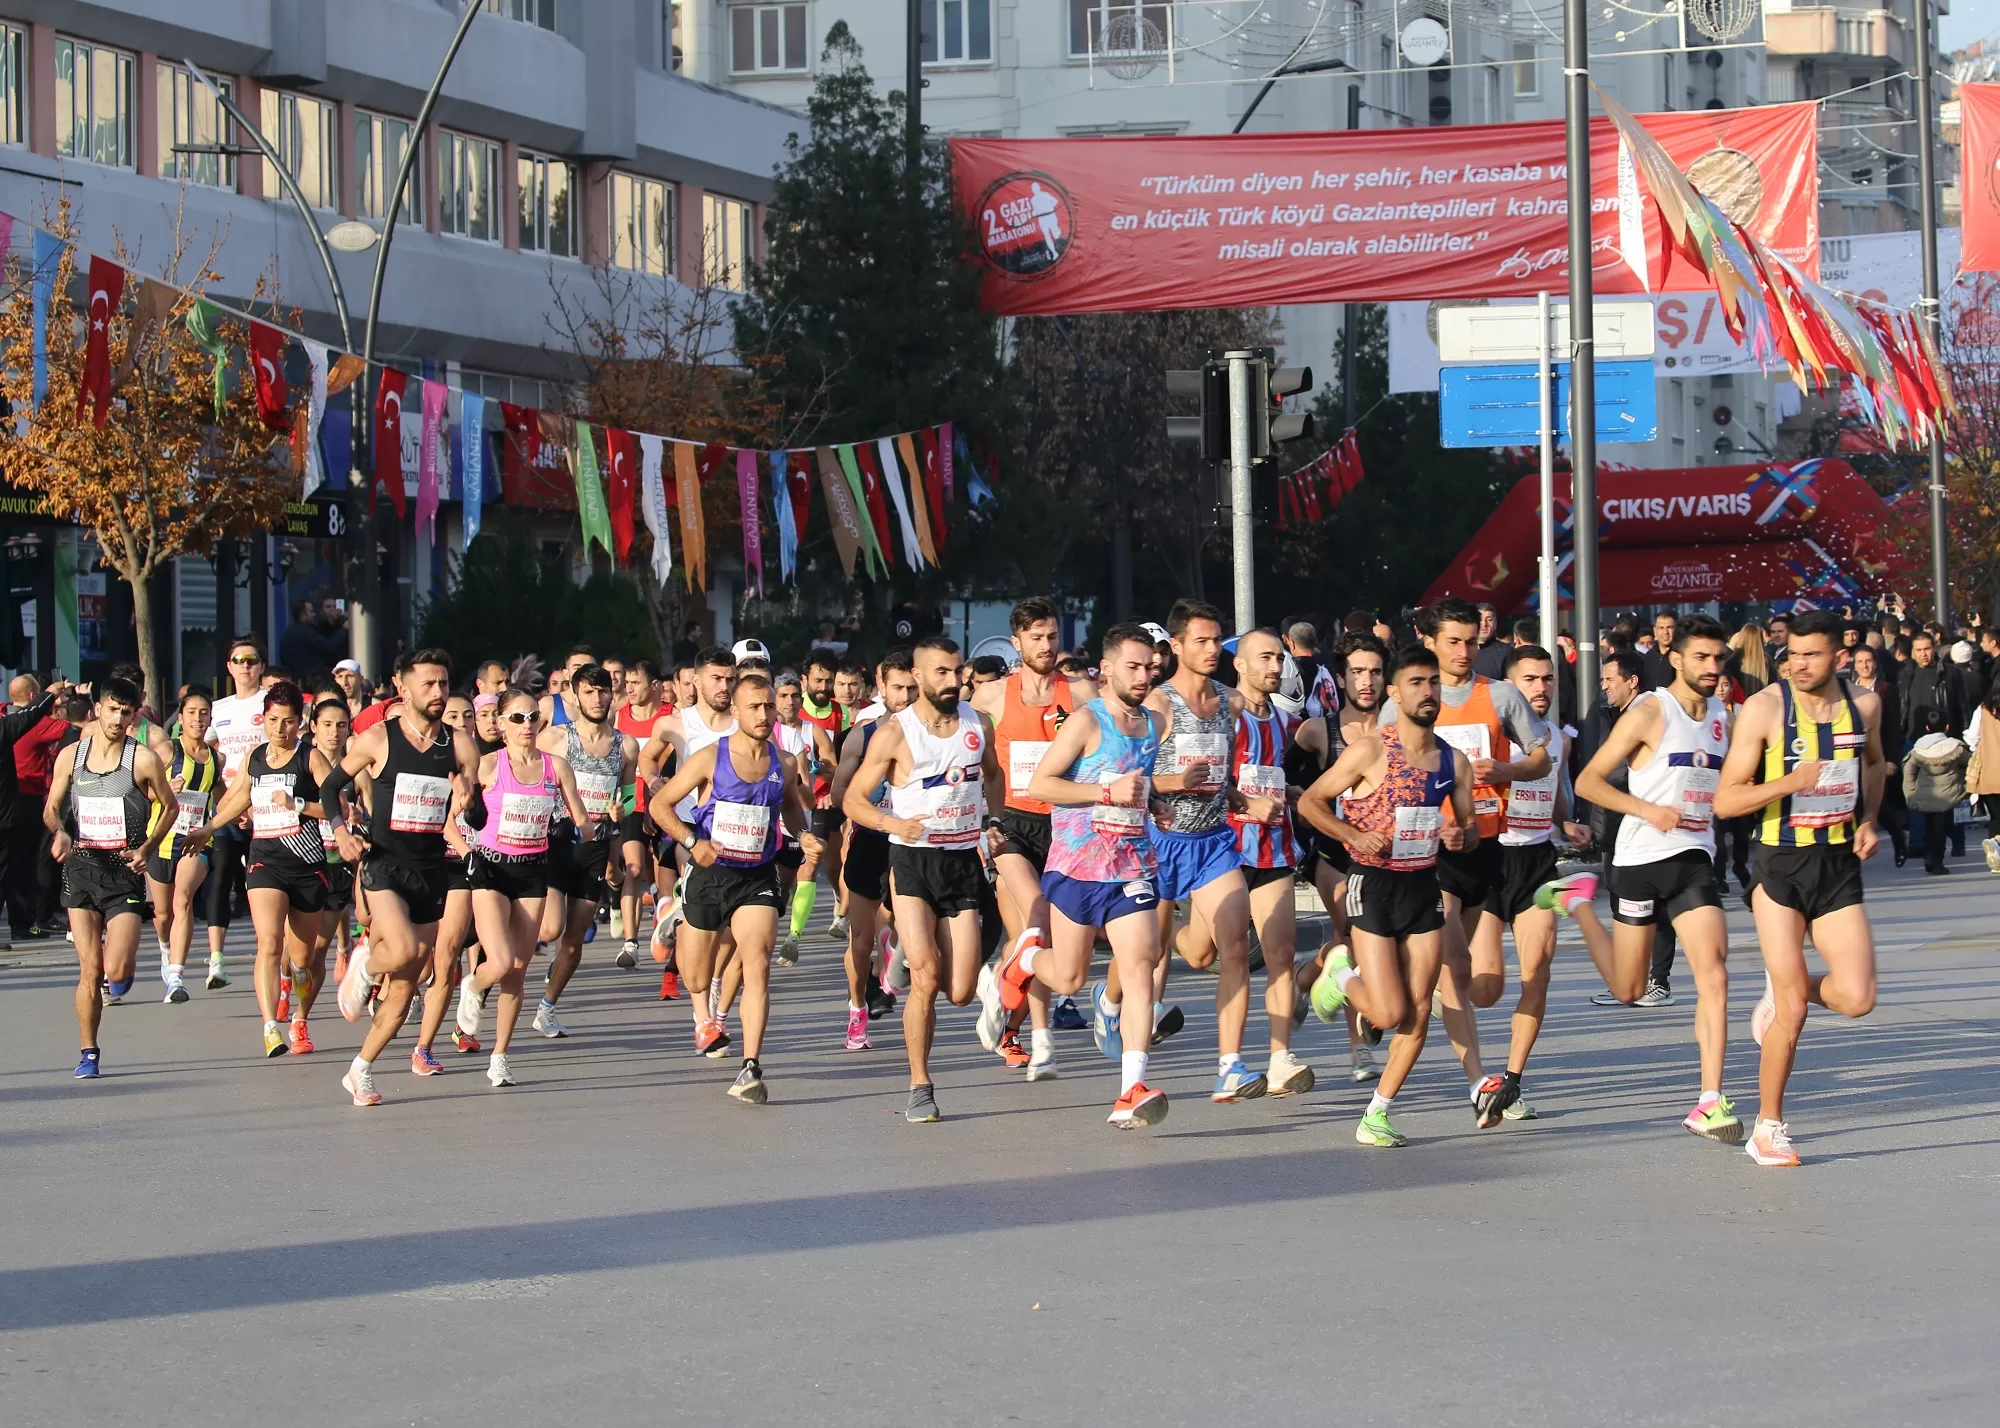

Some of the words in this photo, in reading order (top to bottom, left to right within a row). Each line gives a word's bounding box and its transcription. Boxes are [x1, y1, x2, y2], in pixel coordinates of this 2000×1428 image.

[1241, 172, 1303, 195] diyen
[1311, 169, 1349, 189] her
[1353, 165, 1412, 191] şehir,
[1419, 164, 1457, 186] her
[1462, 161, 1542, 183] kasaba
[1000, 197, 1032, 219] GAZİ
[1110, 213, 1138, 230] en
[1143, 208, 1211, 231] küçük
[1217, 205, 1265, 226] Türk
[1270, 204, 1325, 227] köyü
[1332, 197, 1496, 222] Gazianteplileri
[987, 222, 1036, 247] MARATONU
[1218, 238, 1285, 260] misali
[1290, 236, 1358, 257] olarak
[1602, 492, 1752, 522] ÇIKIŞ/VARIŞ
[1650, 572, 1724, 588] GAZİANTEP
[716, 819, 749, 836] HÜSEYİN
[750, 826, 766, 837] CAN
